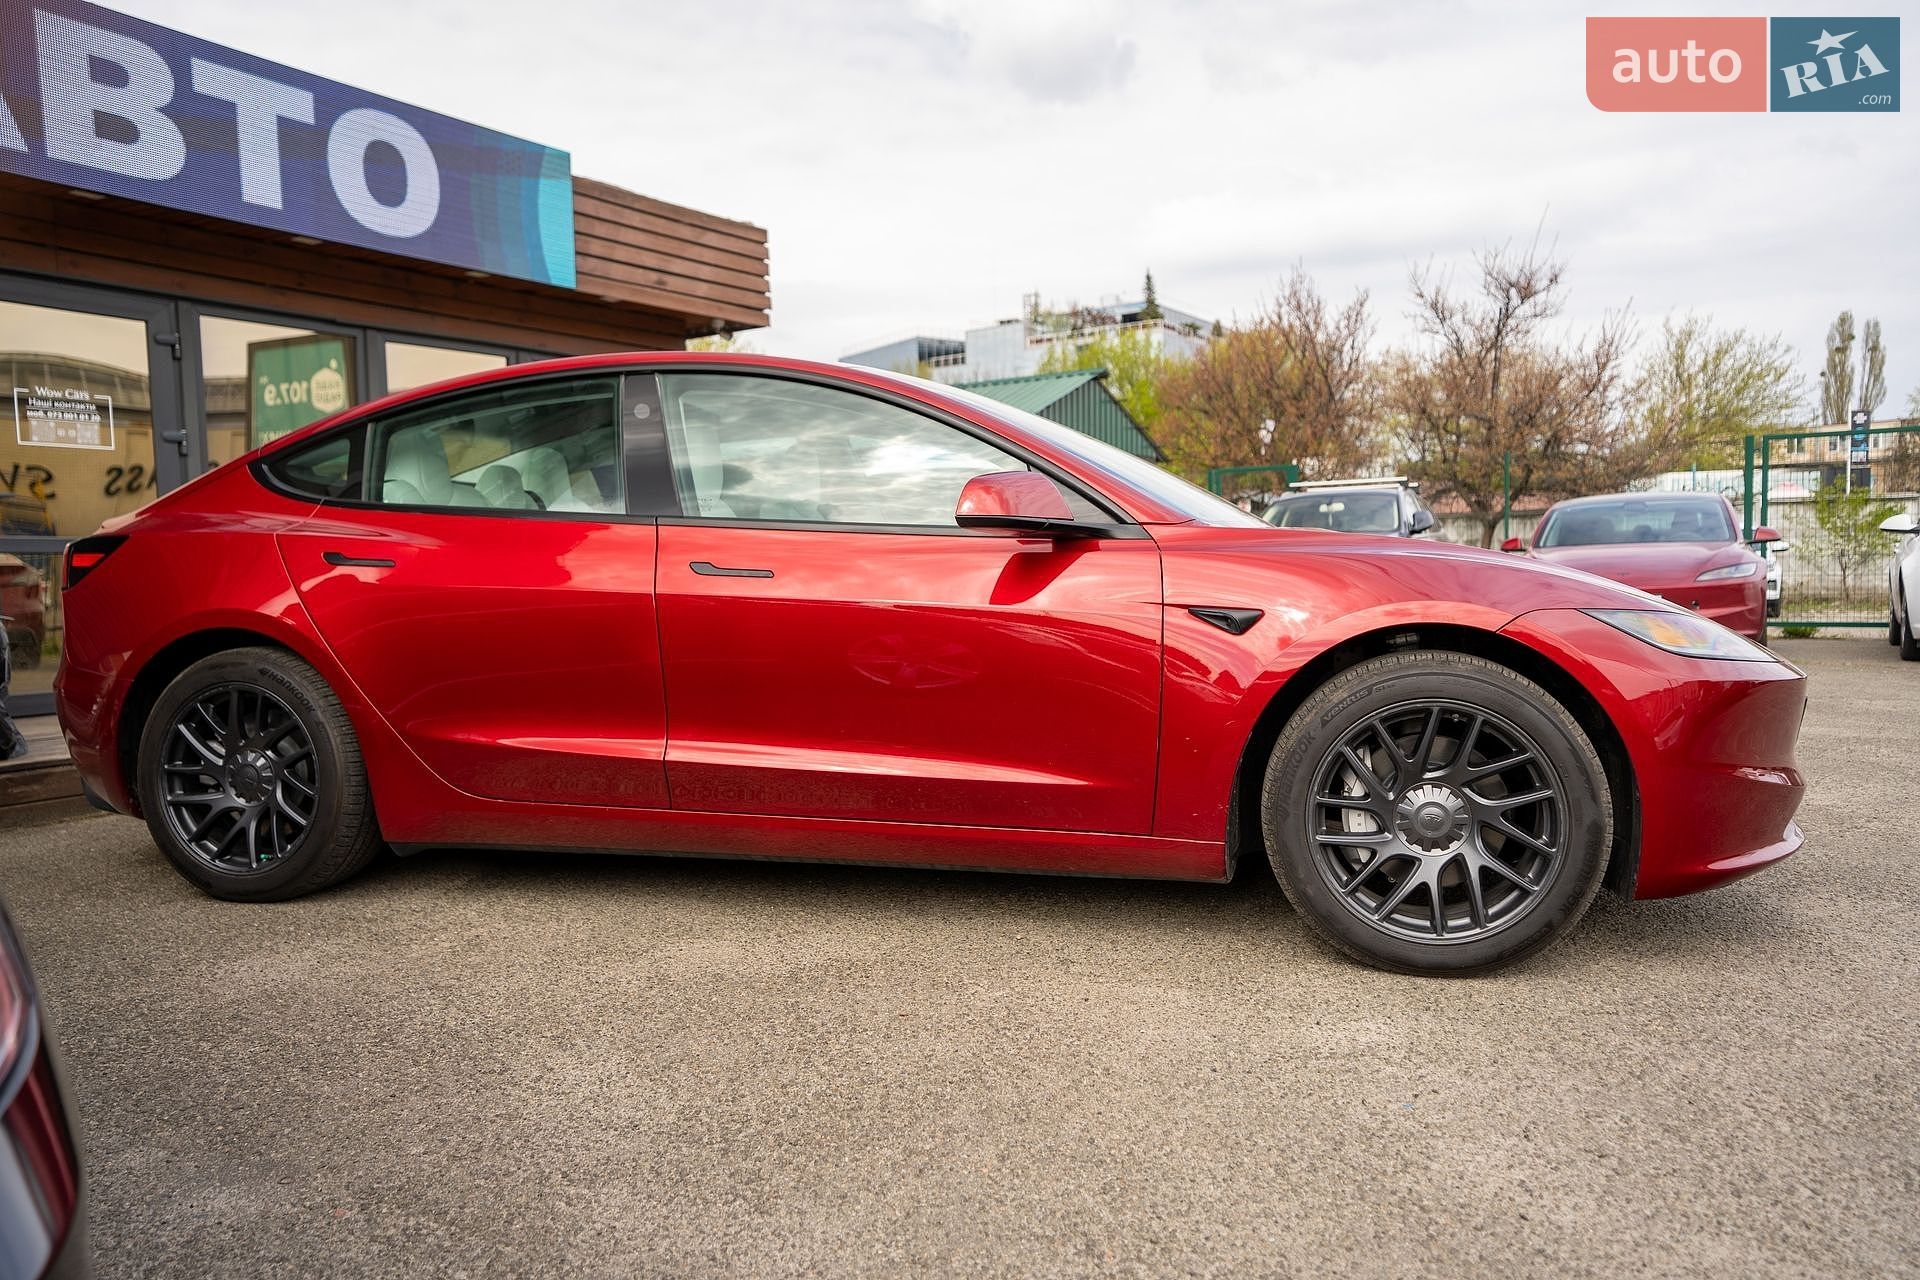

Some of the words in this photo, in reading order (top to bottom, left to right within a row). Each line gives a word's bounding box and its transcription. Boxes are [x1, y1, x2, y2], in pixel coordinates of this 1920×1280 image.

[0, 7, 441, 240] ВТО
[34, 385, 63, 398] Wow
[64, 388, 91, 401] Cars
[28, 396, 53, 407] Наші
